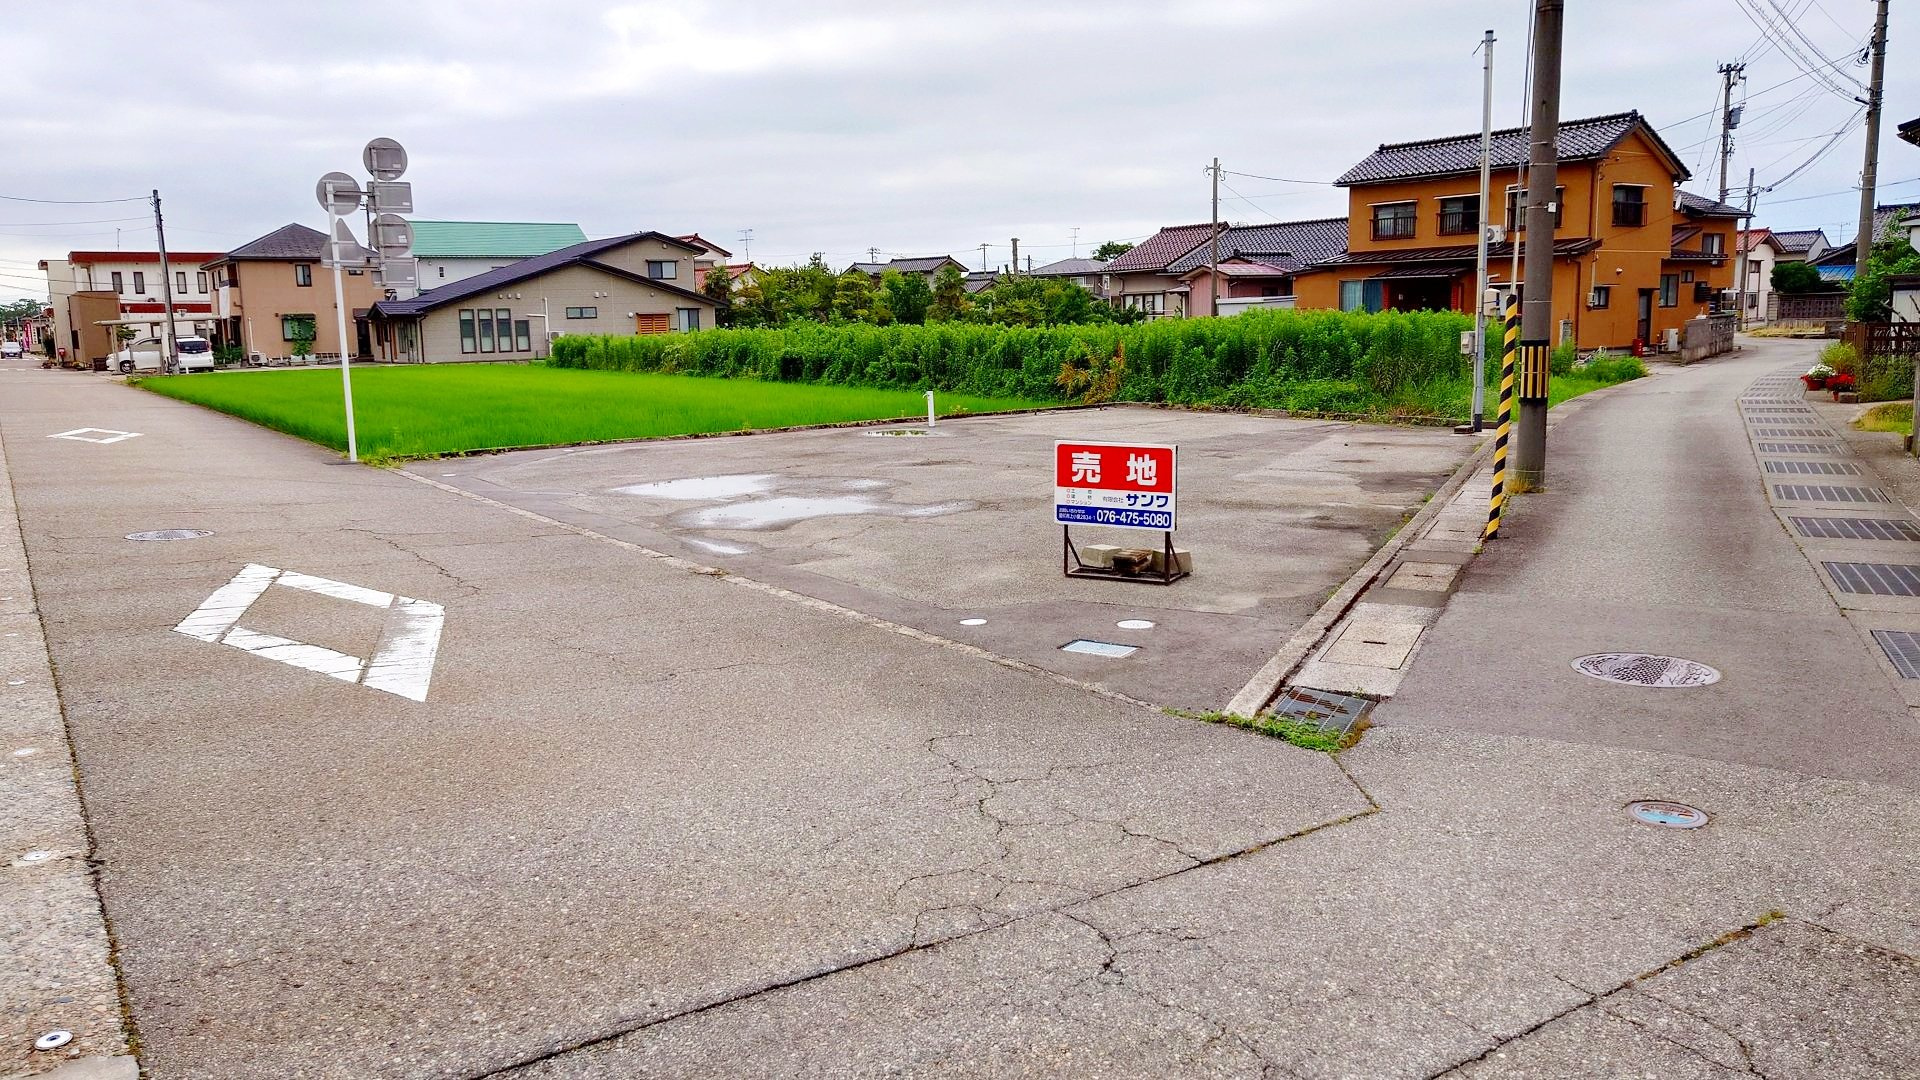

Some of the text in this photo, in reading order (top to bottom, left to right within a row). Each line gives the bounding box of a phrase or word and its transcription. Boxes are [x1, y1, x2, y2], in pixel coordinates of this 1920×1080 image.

[1126, 493, 1169, 508] サンワ
[1096, 509, 1170, 526] 076-475-5080
